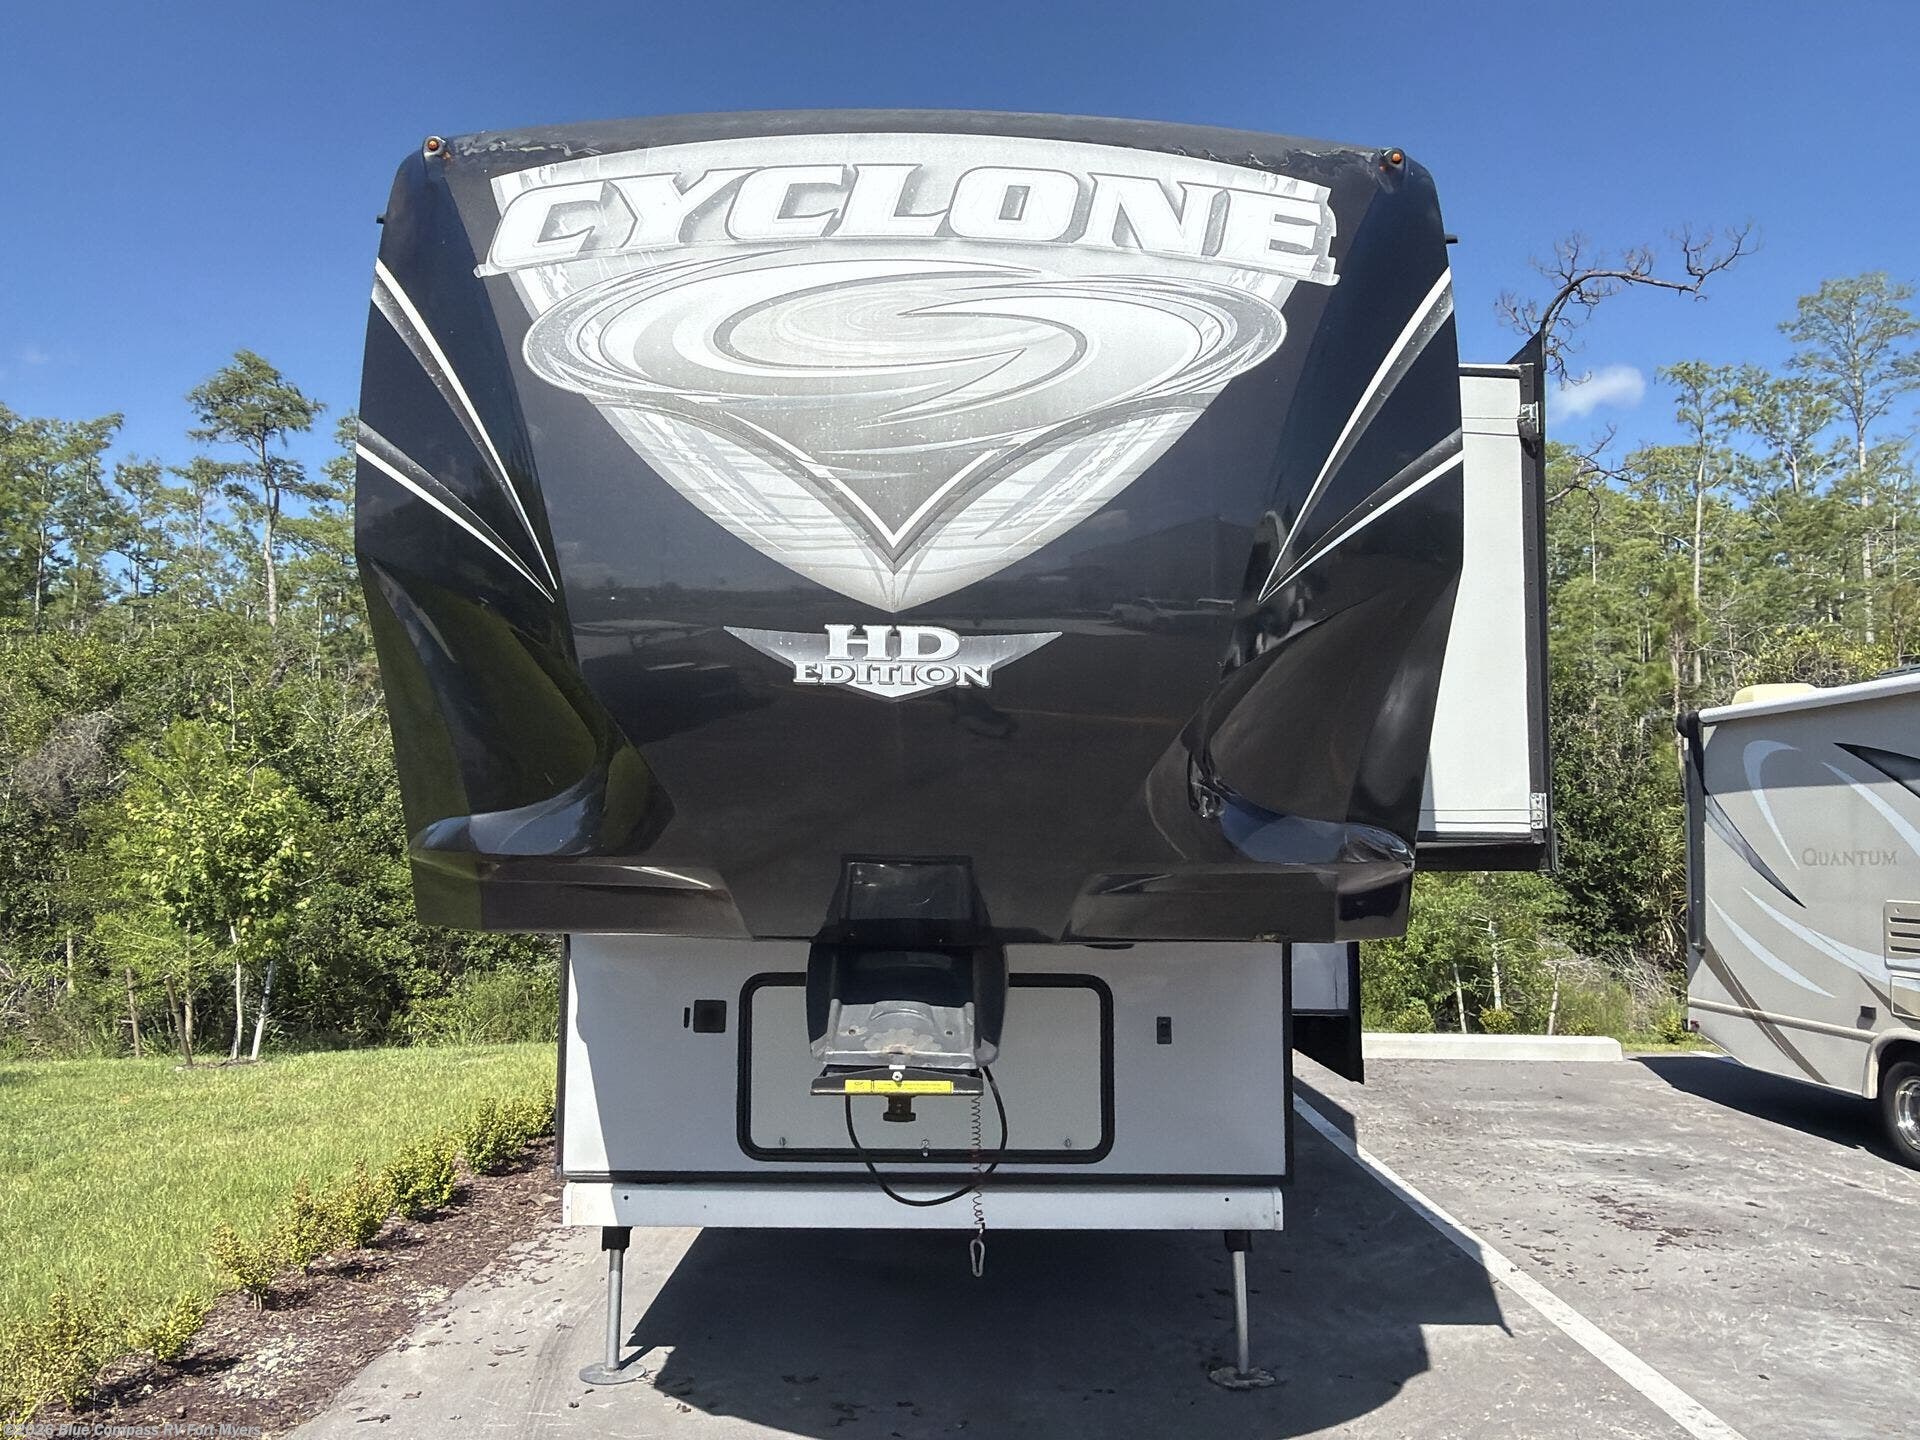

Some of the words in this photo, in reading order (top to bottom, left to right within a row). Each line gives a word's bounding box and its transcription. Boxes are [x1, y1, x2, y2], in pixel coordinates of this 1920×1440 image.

[488, 163, 1332, 278] CYCLONE
[824, 624, 961, 662] HD
[793, 662, 992, 688] EDITION
[1802, 847, 1897, 867] QUANTUM
